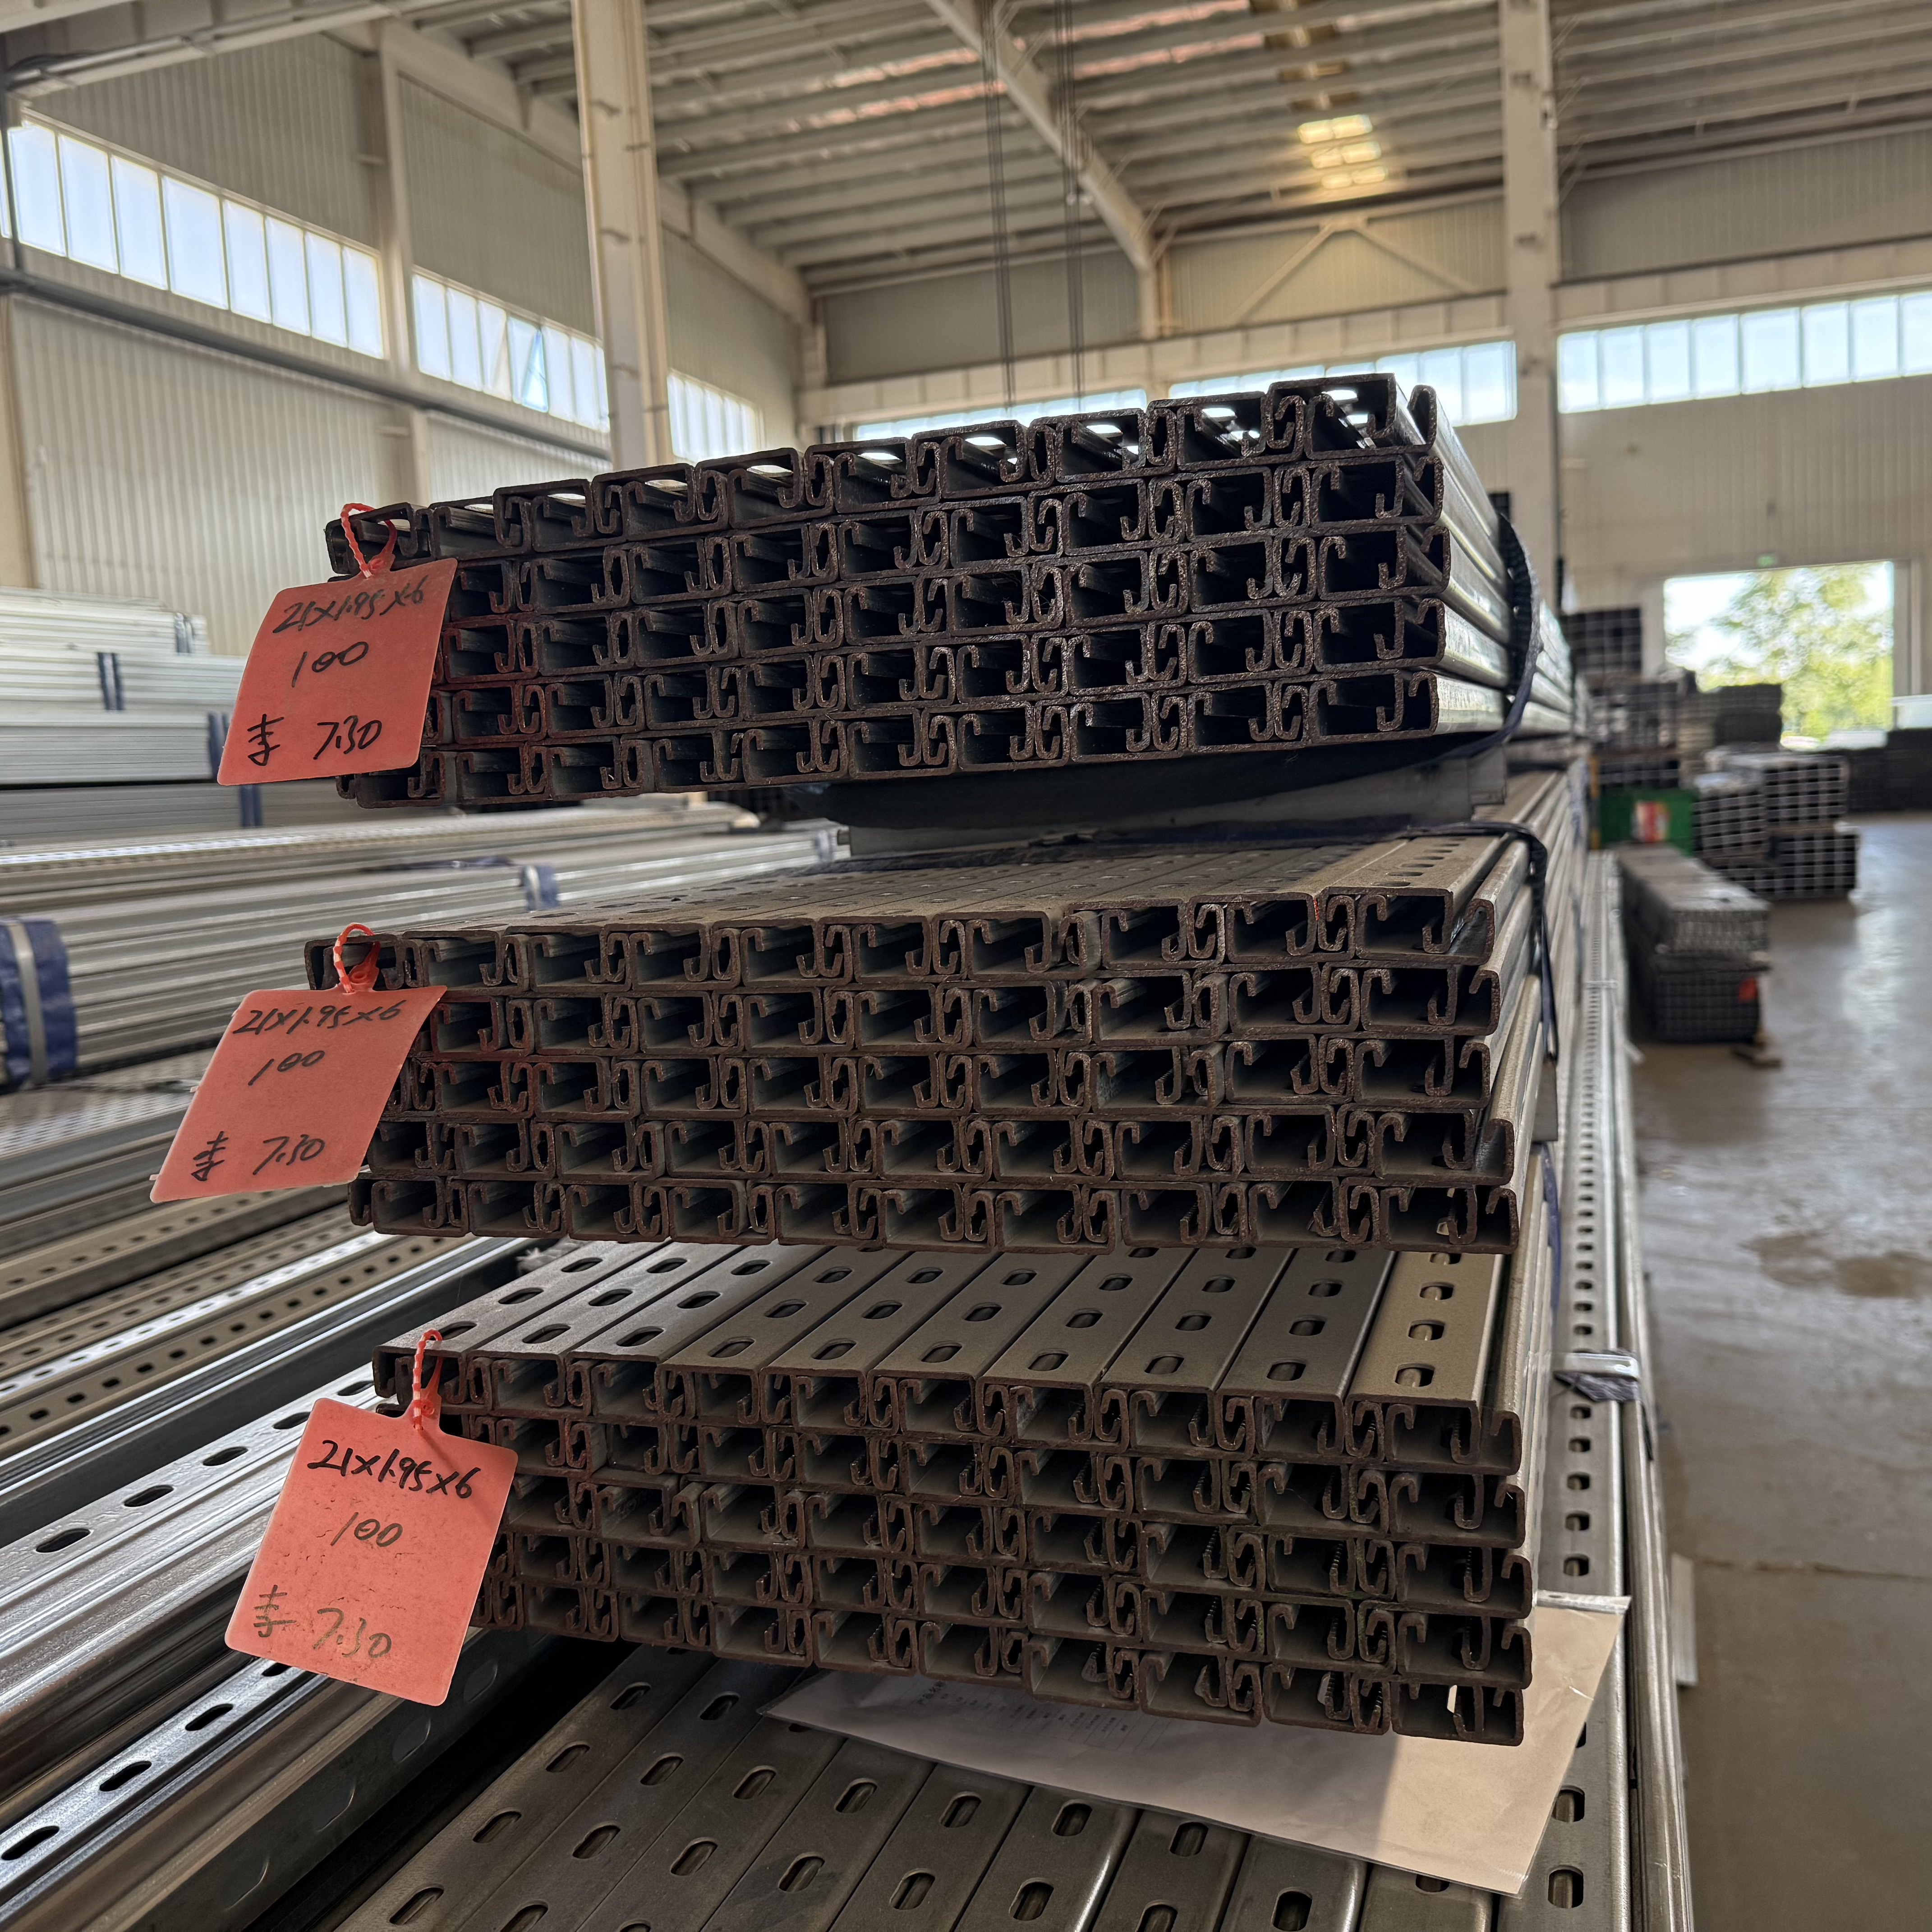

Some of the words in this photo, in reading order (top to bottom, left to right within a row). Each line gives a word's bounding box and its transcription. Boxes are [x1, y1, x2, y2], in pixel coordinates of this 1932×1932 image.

[292, 642, 368, 687] 100
[313, 715, 382, 760] 7.30
[248, 1050, 325, 1086] 100
[331, 1512, 403, 1547] 100
